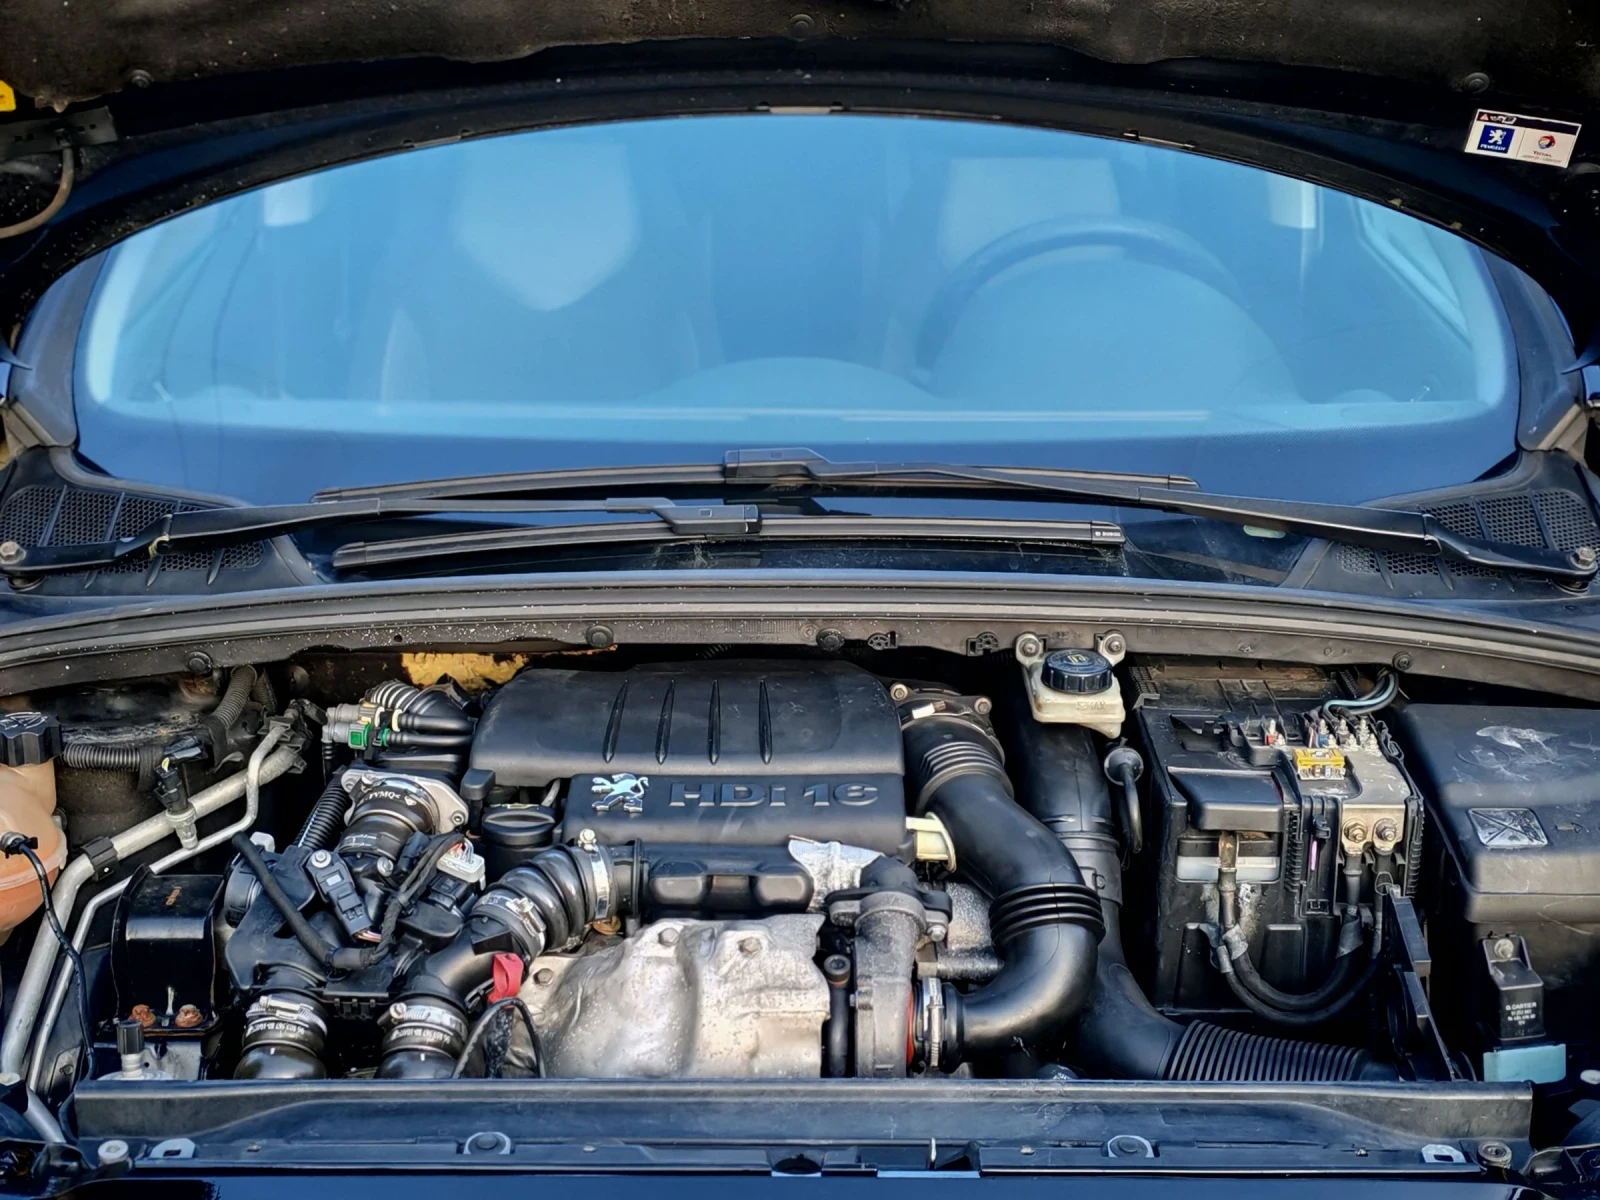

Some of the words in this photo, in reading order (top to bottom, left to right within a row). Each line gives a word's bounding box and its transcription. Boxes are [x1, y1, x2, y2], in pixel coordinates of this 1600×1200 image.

[1480, 143, 1507, 151] PEUGEOT
[1533, 150, 1553, 158] TOTAL
[669, 783, 786, 807] HDi
[804, 783, 879, 806] 16
